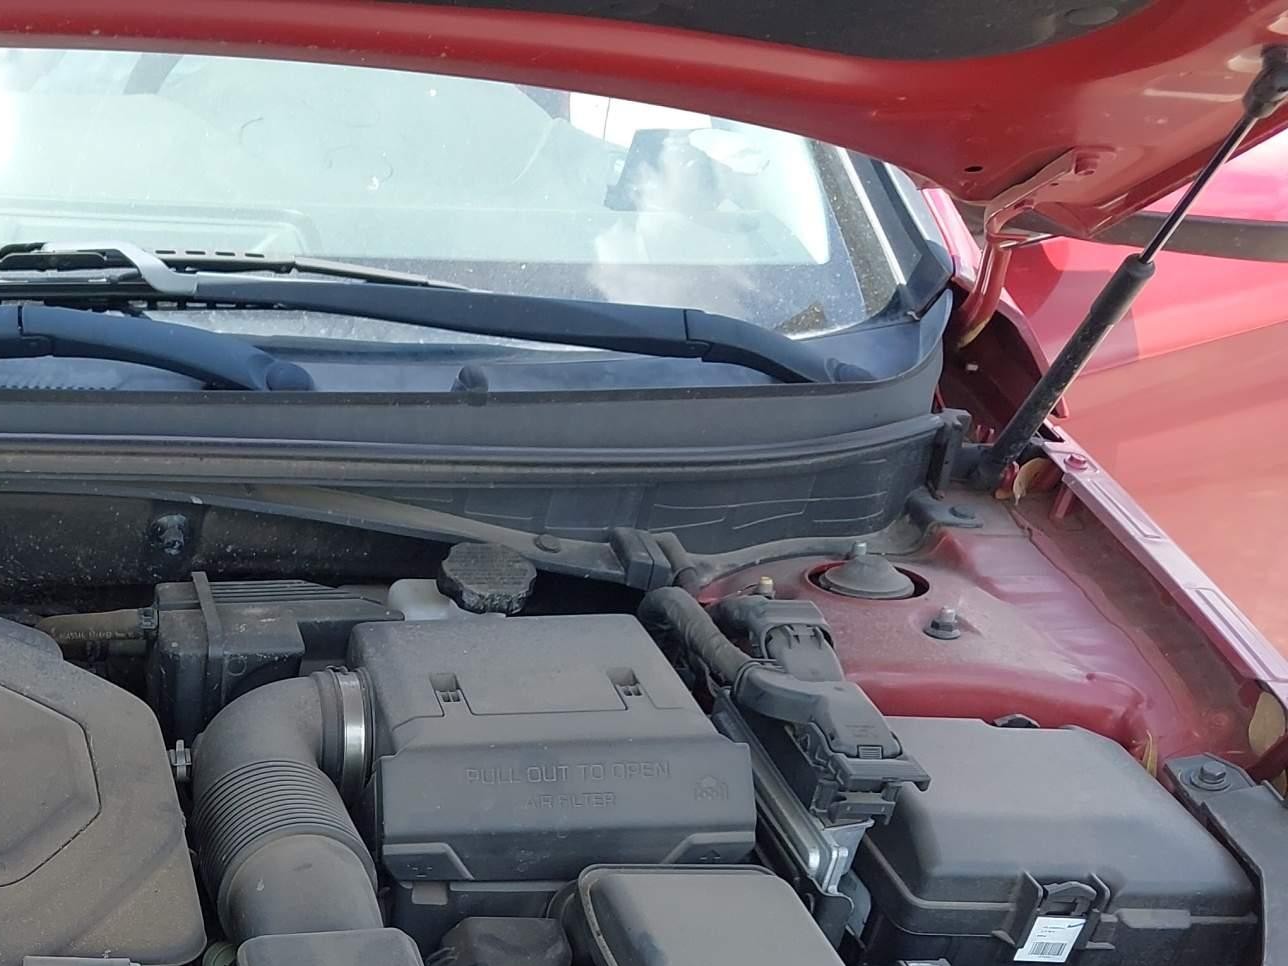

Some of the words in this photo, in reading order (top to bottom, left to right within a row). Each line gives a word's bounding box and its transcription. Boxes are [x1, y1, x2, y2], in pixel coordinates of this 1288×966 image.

[465, 767, 521, 785] PULL
[527, 764, 569, 784] OUT
[575, 763, 603, 782] TO
[611, 760, 672, 781] OPEN
[525, 794, 553, 809] AIR
[558, 791, 616, 808] FILTER
